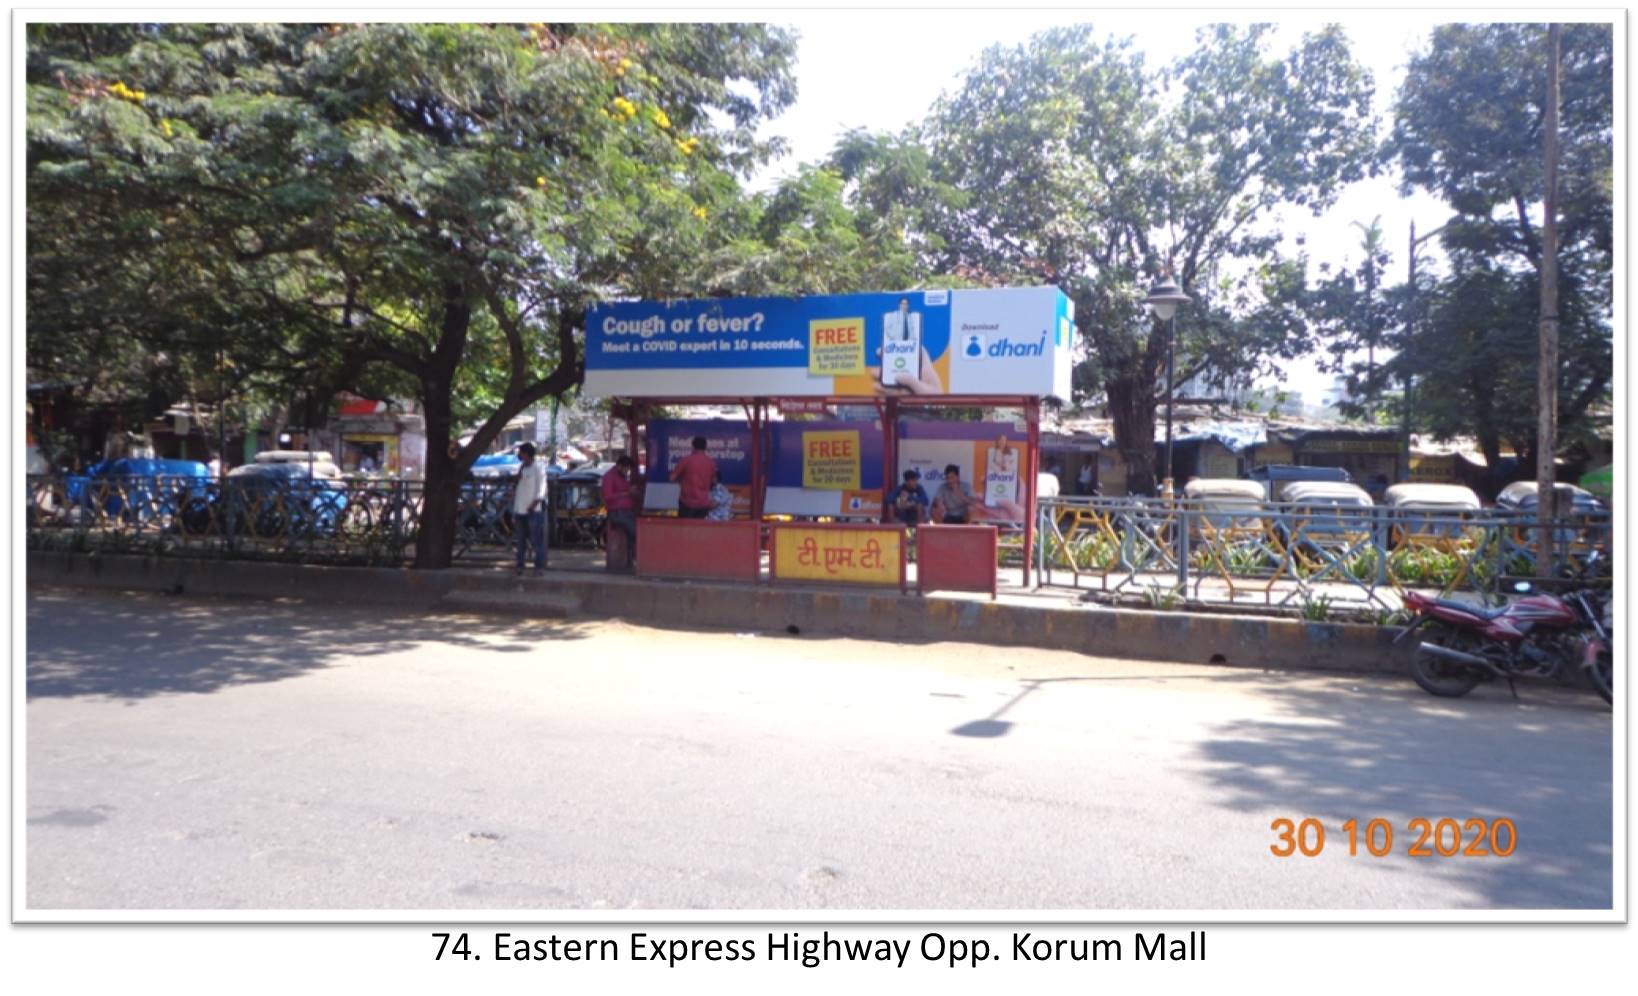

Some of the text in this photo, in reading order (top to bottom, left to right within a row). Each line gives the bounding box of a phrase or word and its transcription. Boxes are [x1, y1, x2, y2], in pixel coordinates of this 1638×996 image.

[603, 312, 765, 338] Cough or fever?
[815, 325, 858, 345] FREE
[988, 329, 1047, 357] dhani
[602, 337, 805, 354] Meet a COVID expert in 10 seconds.
[886, 341, 917, 354] dhani
[809, 440, 853, 458] FREE
[986, 471, 1016, 482] dhani
